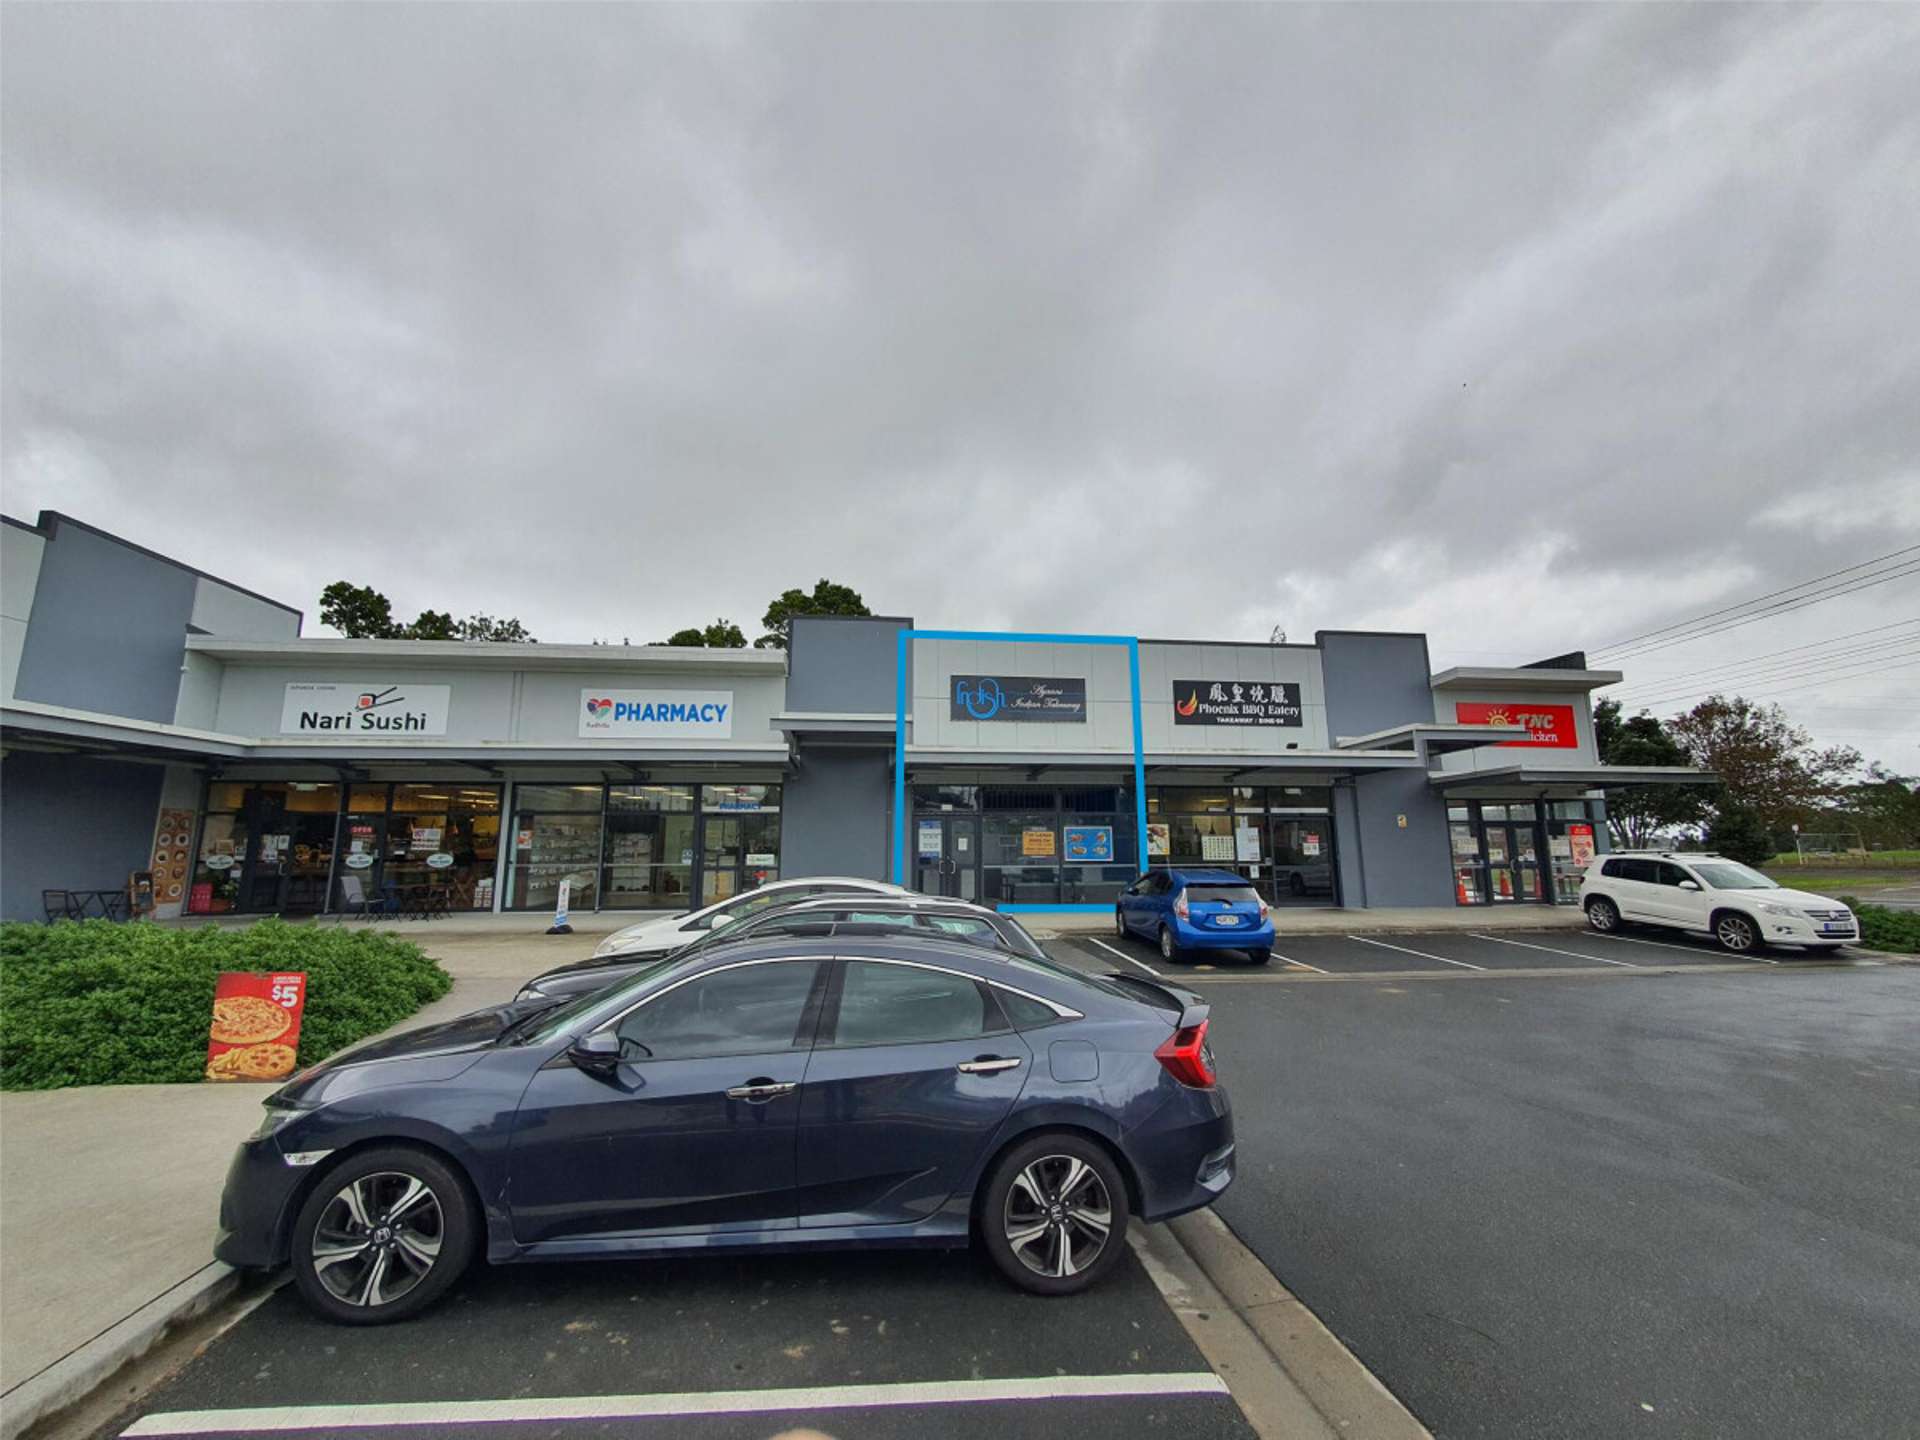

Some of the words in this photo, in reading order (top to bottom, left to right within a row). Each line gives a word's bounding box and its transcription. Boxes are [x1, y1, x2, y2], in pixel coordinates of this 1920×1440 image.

[614, 702, 728, 722] PHARMACY
[1199, 703, 1239, 714] Phoenix
[1242, 704, 1265, 717] BBQ
[1268, 705, 1300, 717] Eatery
[300, 711, 352, 730] Nari
[360, 712, 427, 731] Sushi
[272, 985, 298, 1008] $5
